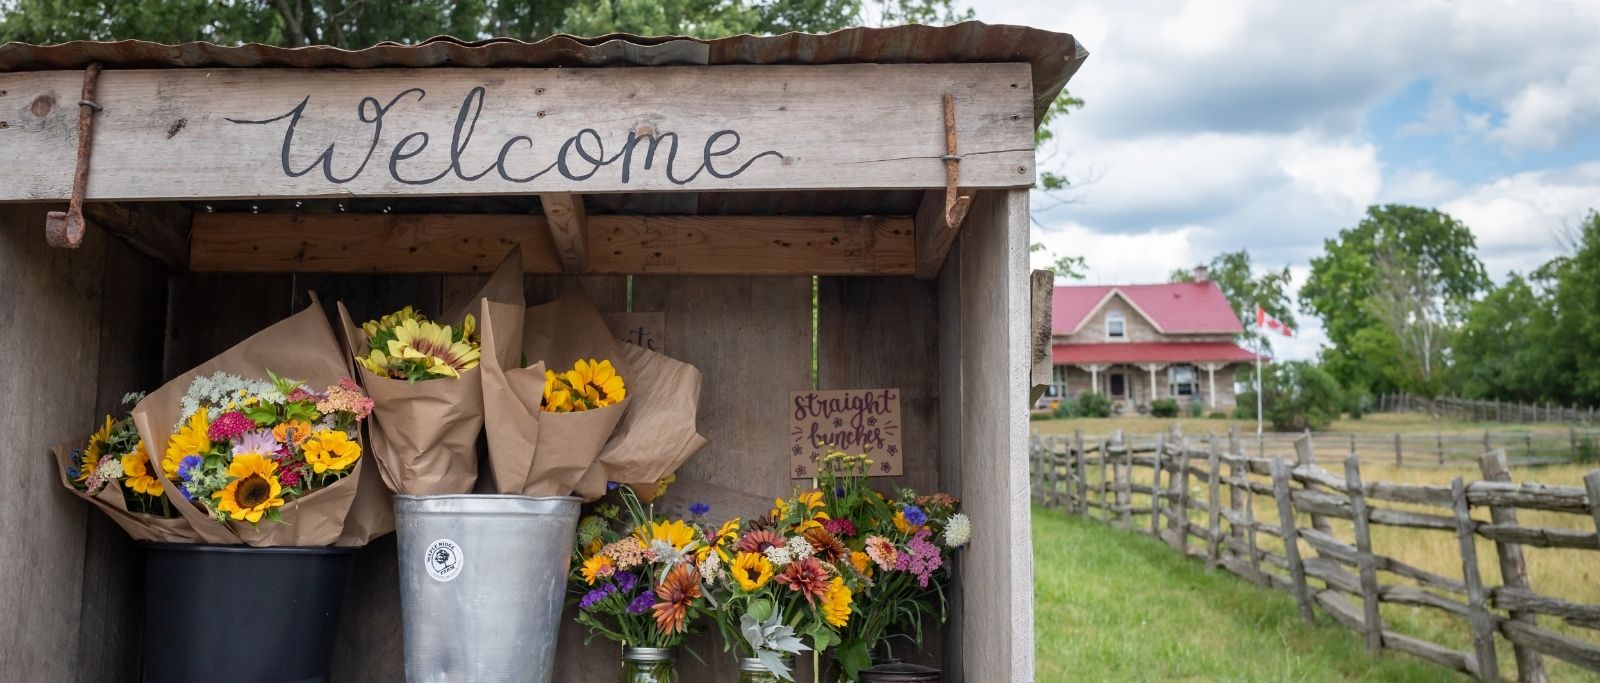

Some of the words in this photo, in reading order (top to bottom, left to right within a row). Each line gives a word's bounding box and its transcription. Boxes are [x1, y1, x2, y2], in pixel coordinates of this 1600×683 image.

[224, 86, 783, 184] Welcome
[795, 390, 896, 429] straight
[807, 422, 885, 452] bunches
[427, 545, 438, 562] MAPLE
[441, 565, 455, 575] FARM
